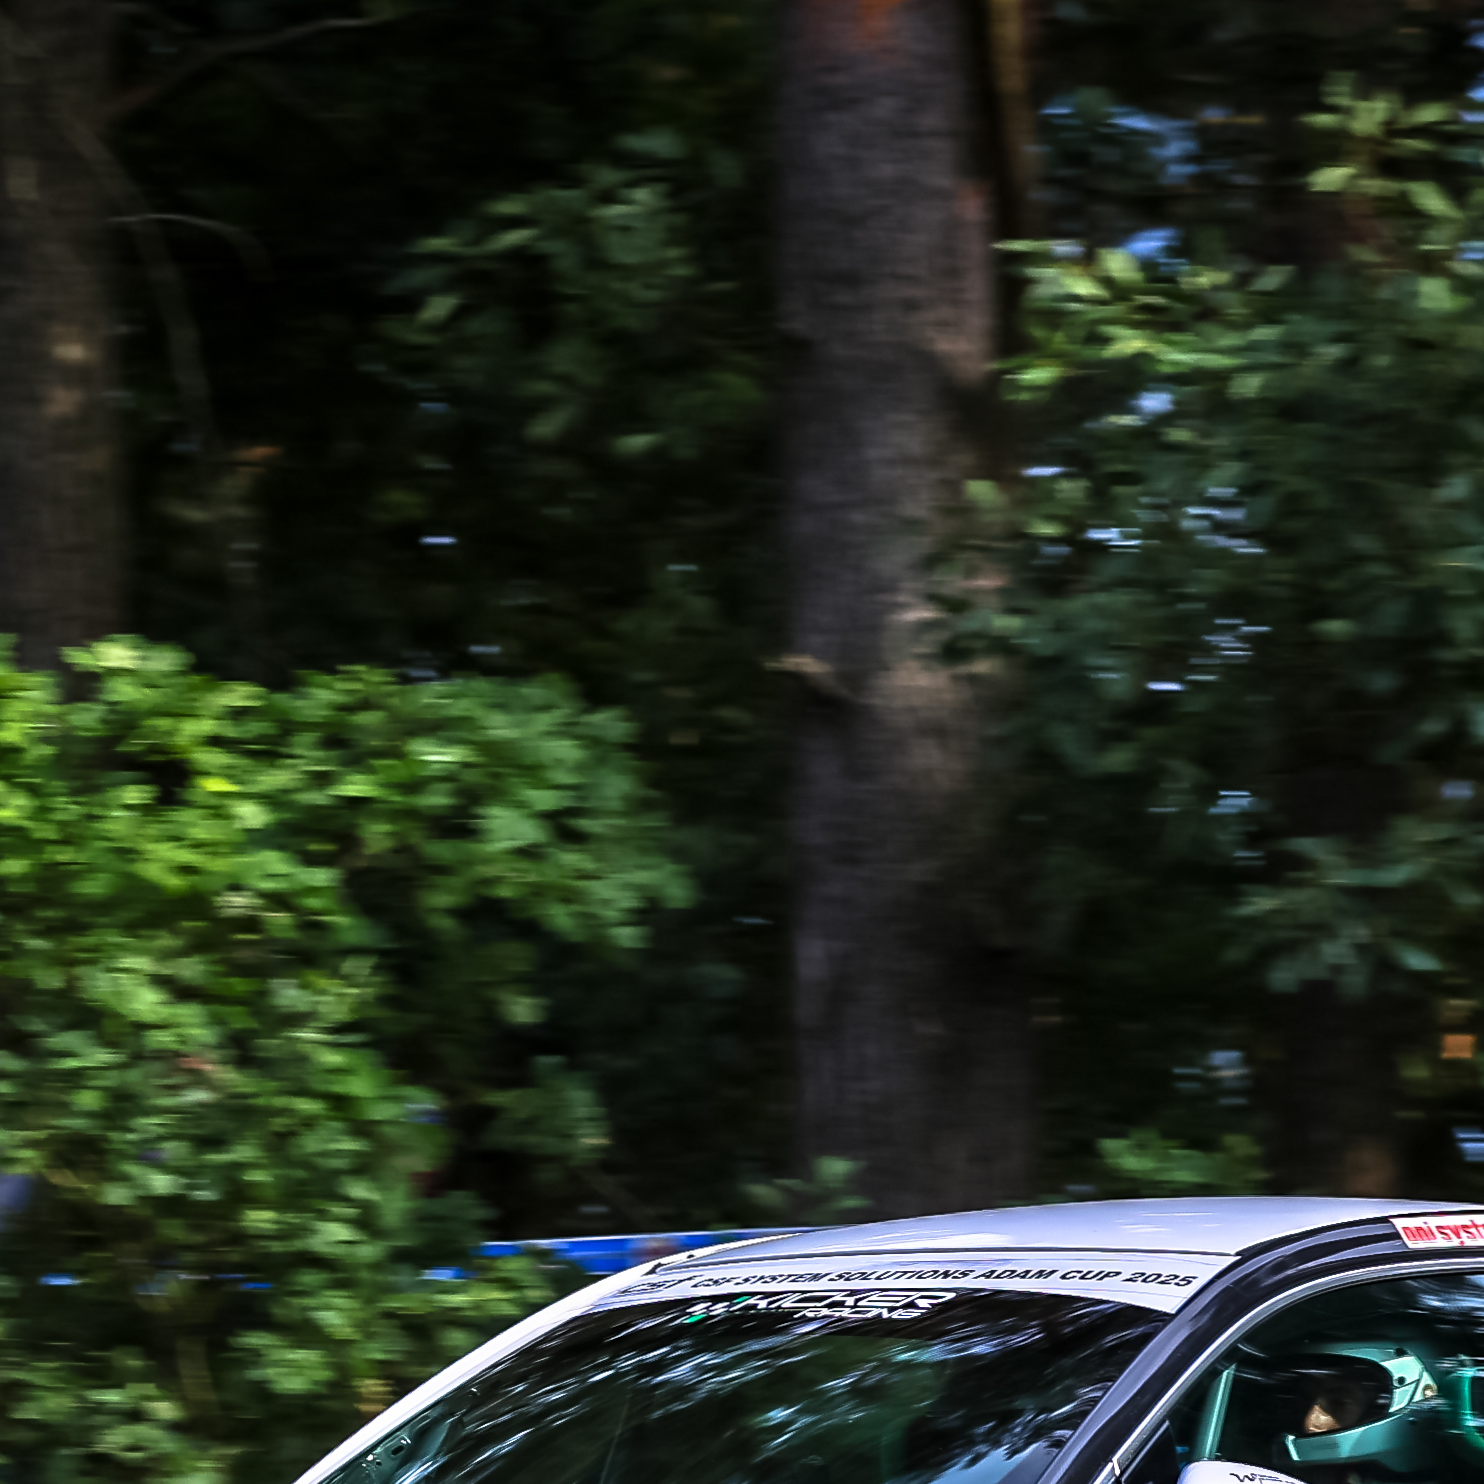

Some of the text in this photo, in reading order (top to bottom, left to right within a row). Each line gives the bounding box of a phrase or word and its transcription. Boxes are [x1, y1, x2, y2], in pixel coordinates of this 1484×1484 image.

[690, 1269, 1199, 1289] CSF SYSTEM SOLUTIONS ADAM CUP 2025
[729, 1290, 957, 1311] KICKER
[793, 1307, 930, 1319] RACING
